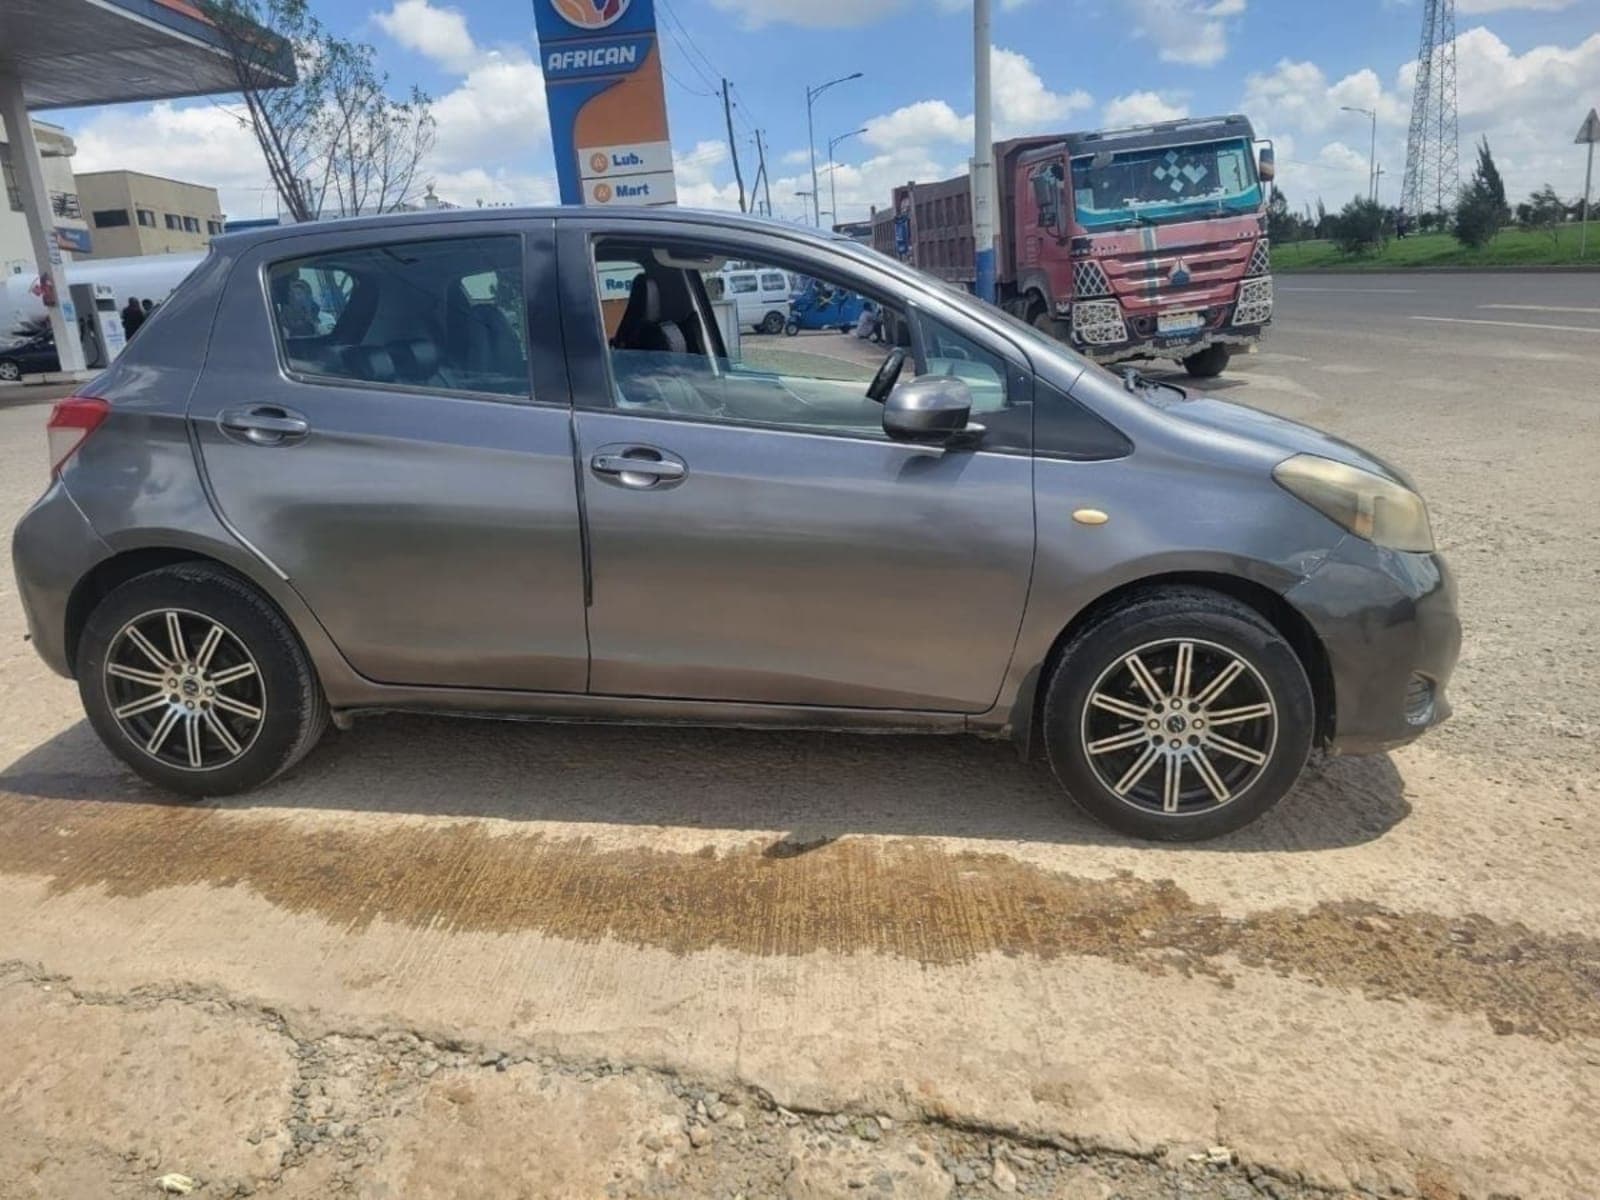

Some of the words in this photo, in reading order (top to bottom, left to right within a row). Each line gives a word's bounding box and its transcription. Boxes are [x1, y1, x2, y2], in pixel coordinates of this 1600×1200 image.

[548, 45, 636, 71] AFRICAN
[612, 152, 644, 166] Lub.
[616, 183, 650, 198] Mart
